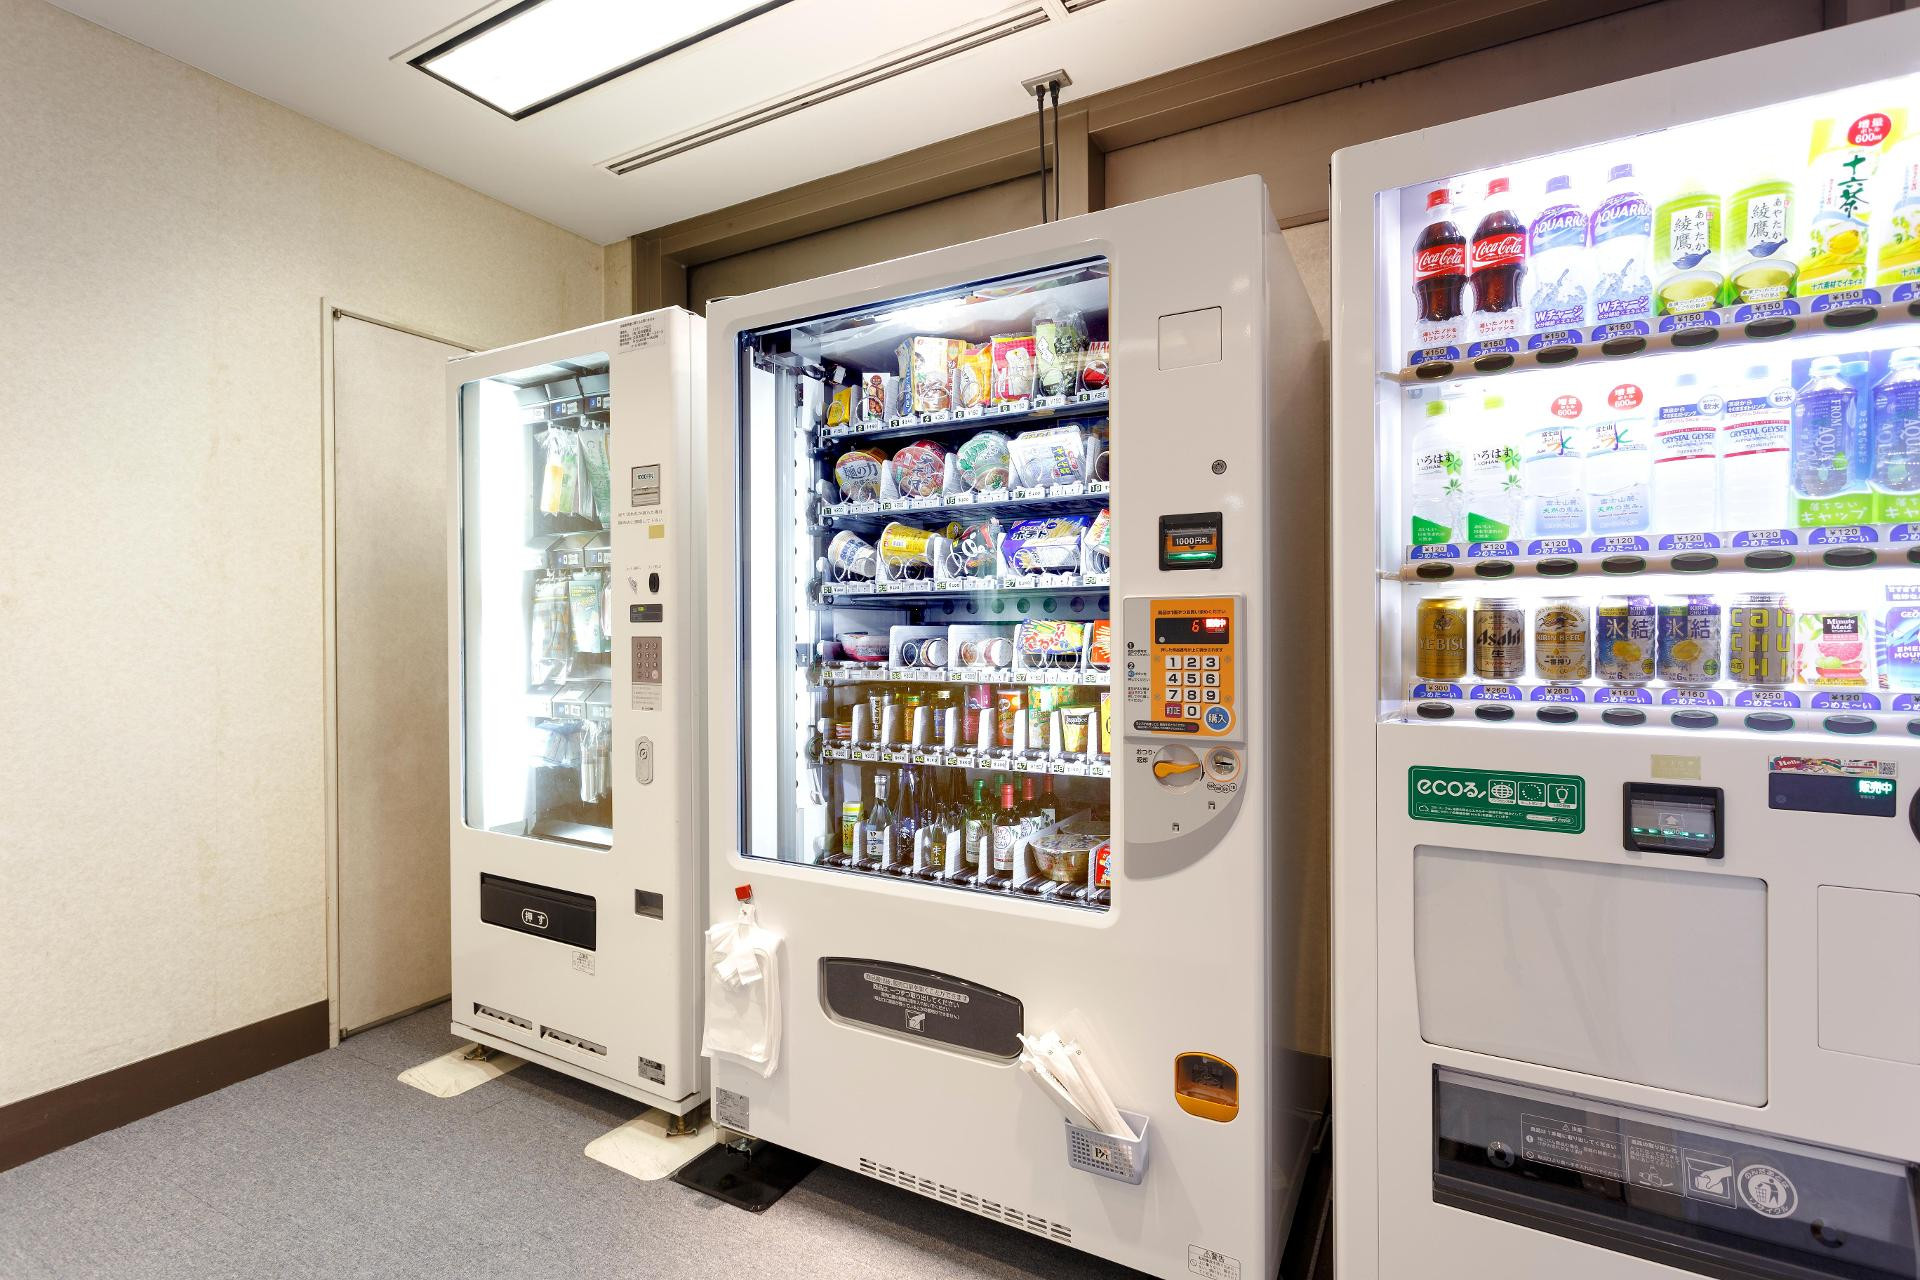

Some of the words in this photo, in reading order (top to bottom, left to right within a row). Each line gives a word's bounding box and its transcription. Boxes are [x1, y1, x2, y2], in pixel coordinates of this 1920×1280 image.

[1837, 154, 1870, 219] 十六茶
[1750, 202, 1771, 239] 綾鷹
[1772, 197, 1783, 240] あやたか
[1673, 215, 1693, 251] 綾鷹
[1695, 210, 1706, 251] あやたか
[1475, 236, 1522, 260] Coca-Cola
[1418, 247, 1463, 271] Coca-Cola
[1597, 296, 1649, 313] Wチャージ
[1534, 305, 1584, 322] Wチャージ
[1830, 400, 1843, 426] FROM
[1730, 427, 1759, 438] CRYSTAL
[1662, 434, 1689, 445] CRYSTAL
[1416, 452, 1455, 466] いろはす
[1473, 447, 1514, 462] いろはす
[1802, 507, 1869, 523] キャップ
[1012, 529, 1048, 541] ポテト
[1751, 531, 1779, 539] ¥120
[1829, 527, 1858, 537] ¥120
[1175, 536, 1210, 545] 1000円札
[1608, 537, 1633, 545] ¥120
[1676, 534, 1702, 542] ¥120
[1543, 540, 1567, 548] ¥120
[1191, 619, 1200, 633] 6
[1606, 618, 1649, 639] 氷結
[1666, 618, 1711, 639] 氷結
[1476, 628, 1521, 647] Asahi
[1491, 650, 1505, 658] 生
[1169, 657, 1176, 667] 1
[1187, 657, 1197, 667] 2
[1206, 657, 1216, 668] 3
[1544, 657, 1573, 666] 一番搾り
[1168, 673, 1178, 684] 4
[1187, 673, 1197, 684] 5
[1205, 673, 1216, 684] 6
[1428, 684, 1449, 692] ¥300
[1485, 686, 1507, 694] ¥260
[1546, 687, 1570, 695] ¥260
[1611, 689, 1635, 697] ¥160
[1168, 689, 1178, 700] 7
[1187, 690, 1197, 700] 8
[1206, 690, 1216, 701] 9
[1679, 690, 1706, 698] ¥160
[1754, 691, 1781, 700] ¥250
[1187, 706, 1197, 717] 0
[1208, 713, 1228, 724] 購入
[524, 911, 546, 926] 押す
